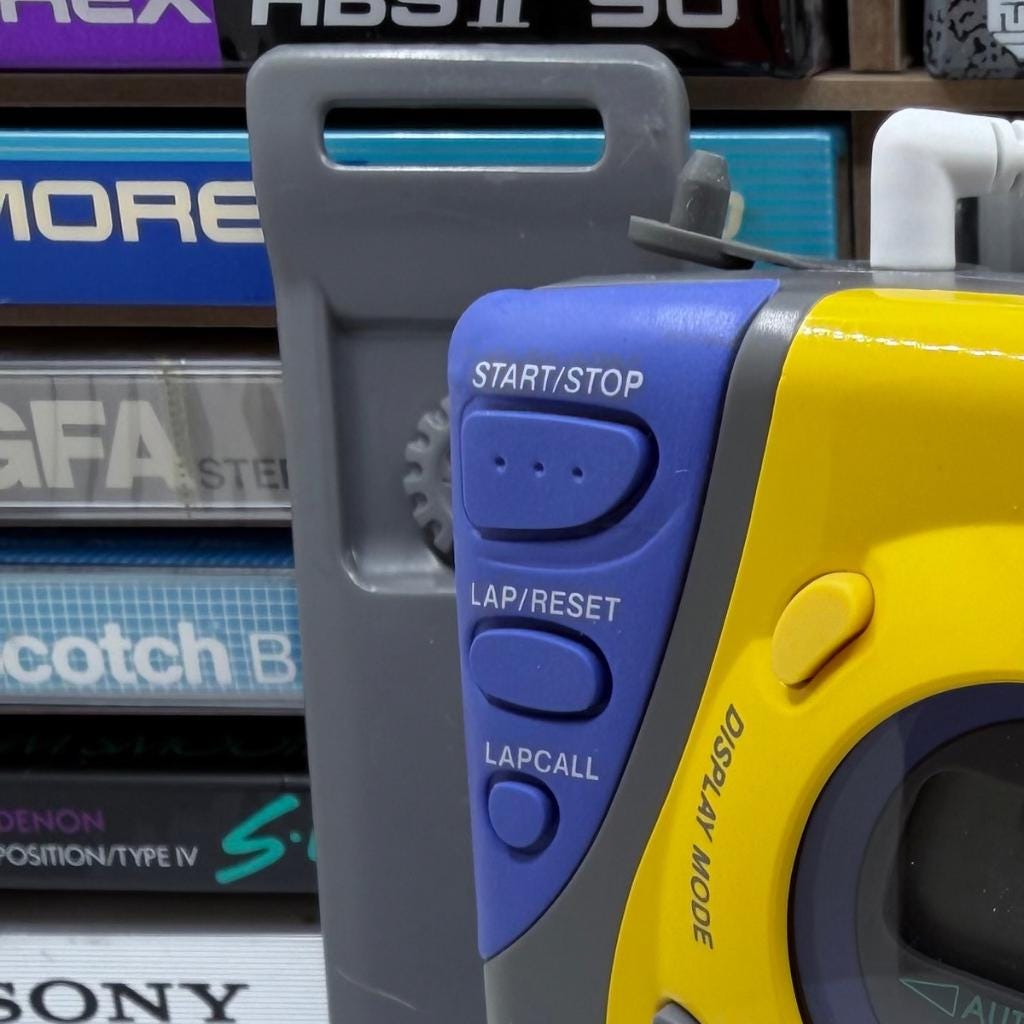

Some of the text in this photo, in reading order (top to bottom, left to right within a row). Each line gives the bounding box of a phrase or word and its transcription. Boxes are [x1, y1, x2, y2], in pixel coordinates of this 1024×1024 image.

[471, 361, 644, 398] START/STOP
[470, 582, 622, 623] LAP/RESET
[0, 622, 233, 686] cotch
[485, 741, 601, 782] LAPCALL
[0, 809, 105, 834] DENON
[690, 703, 745, 950] DISPLAY MODE
[176, 847, 199, 867] IV
